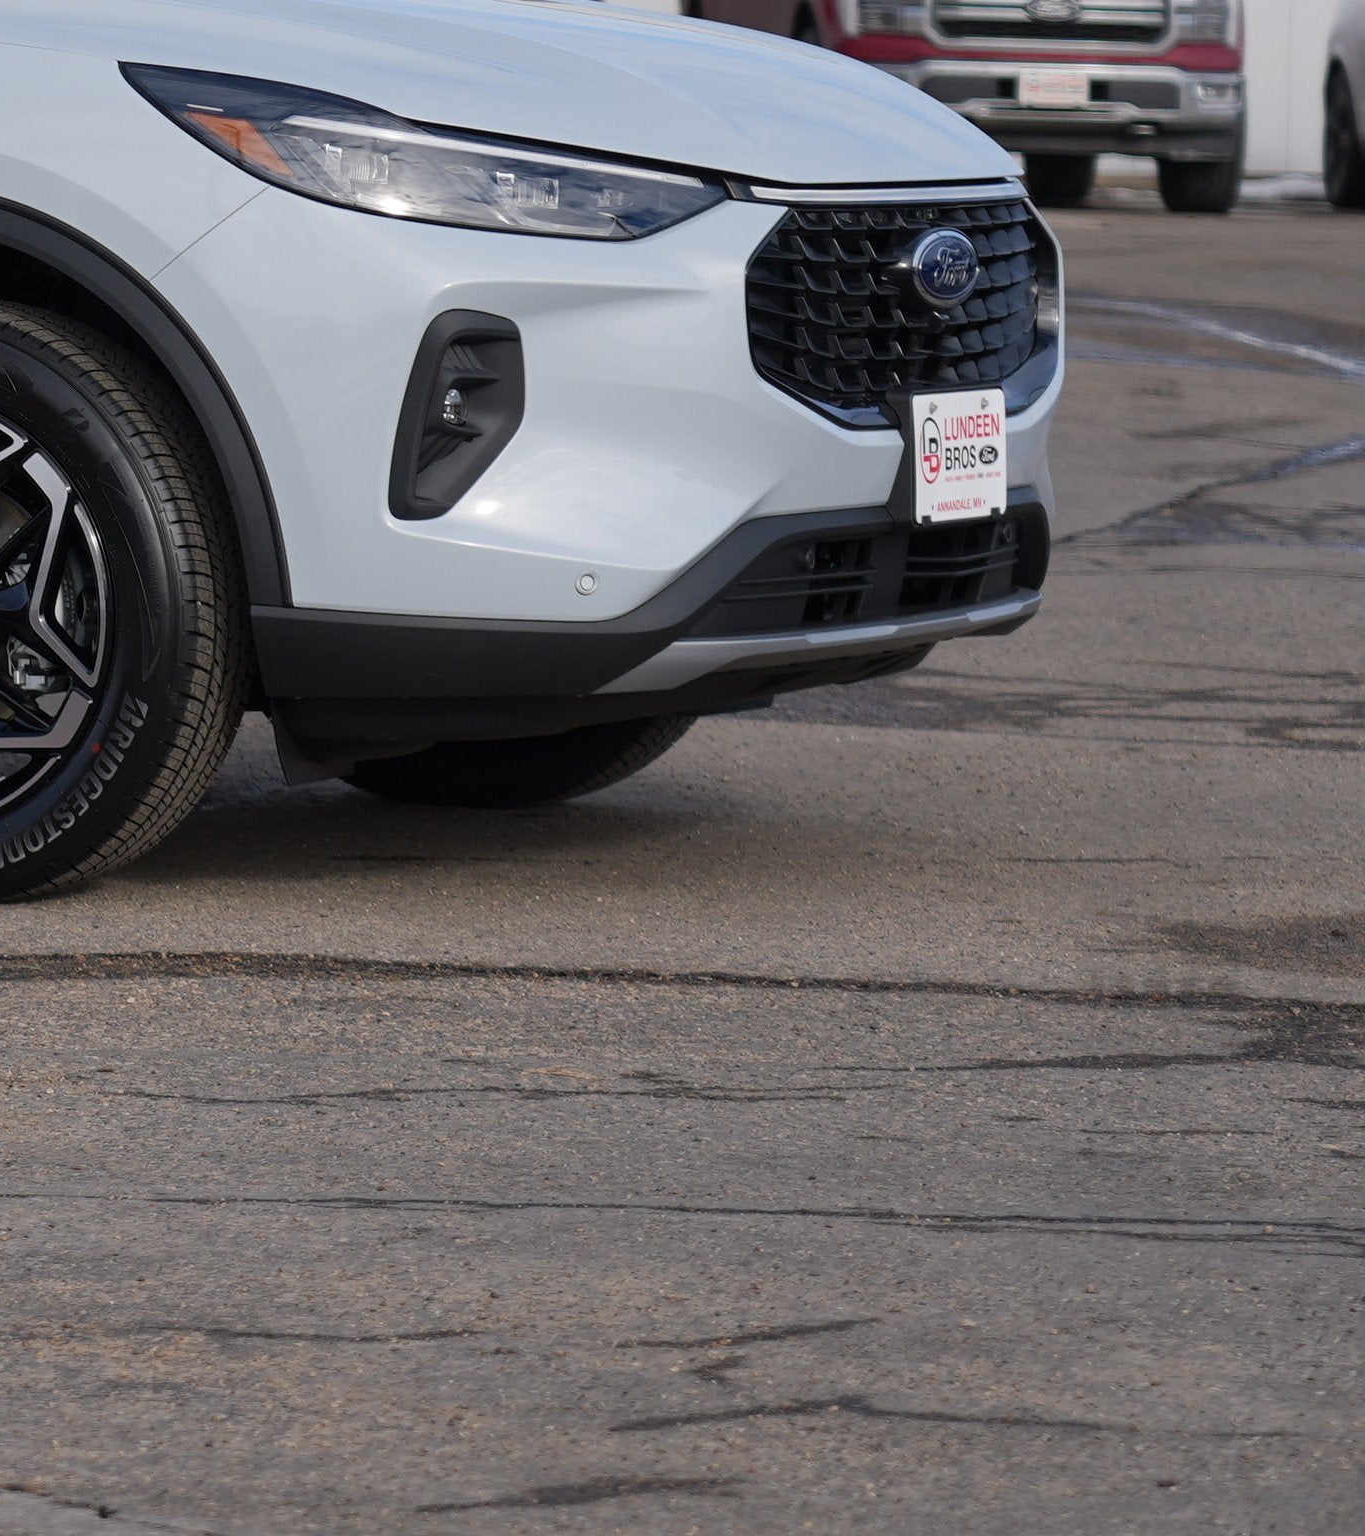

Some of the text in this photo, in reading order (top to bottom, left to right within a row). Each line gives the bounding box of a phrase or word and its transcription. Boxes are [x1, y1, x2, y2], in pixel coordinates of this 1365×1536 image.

[934, 247, 969, 288] Ford
[944, 413, 1000, 441] LUNDEEN
[945, 445, 976, 470] BROS
